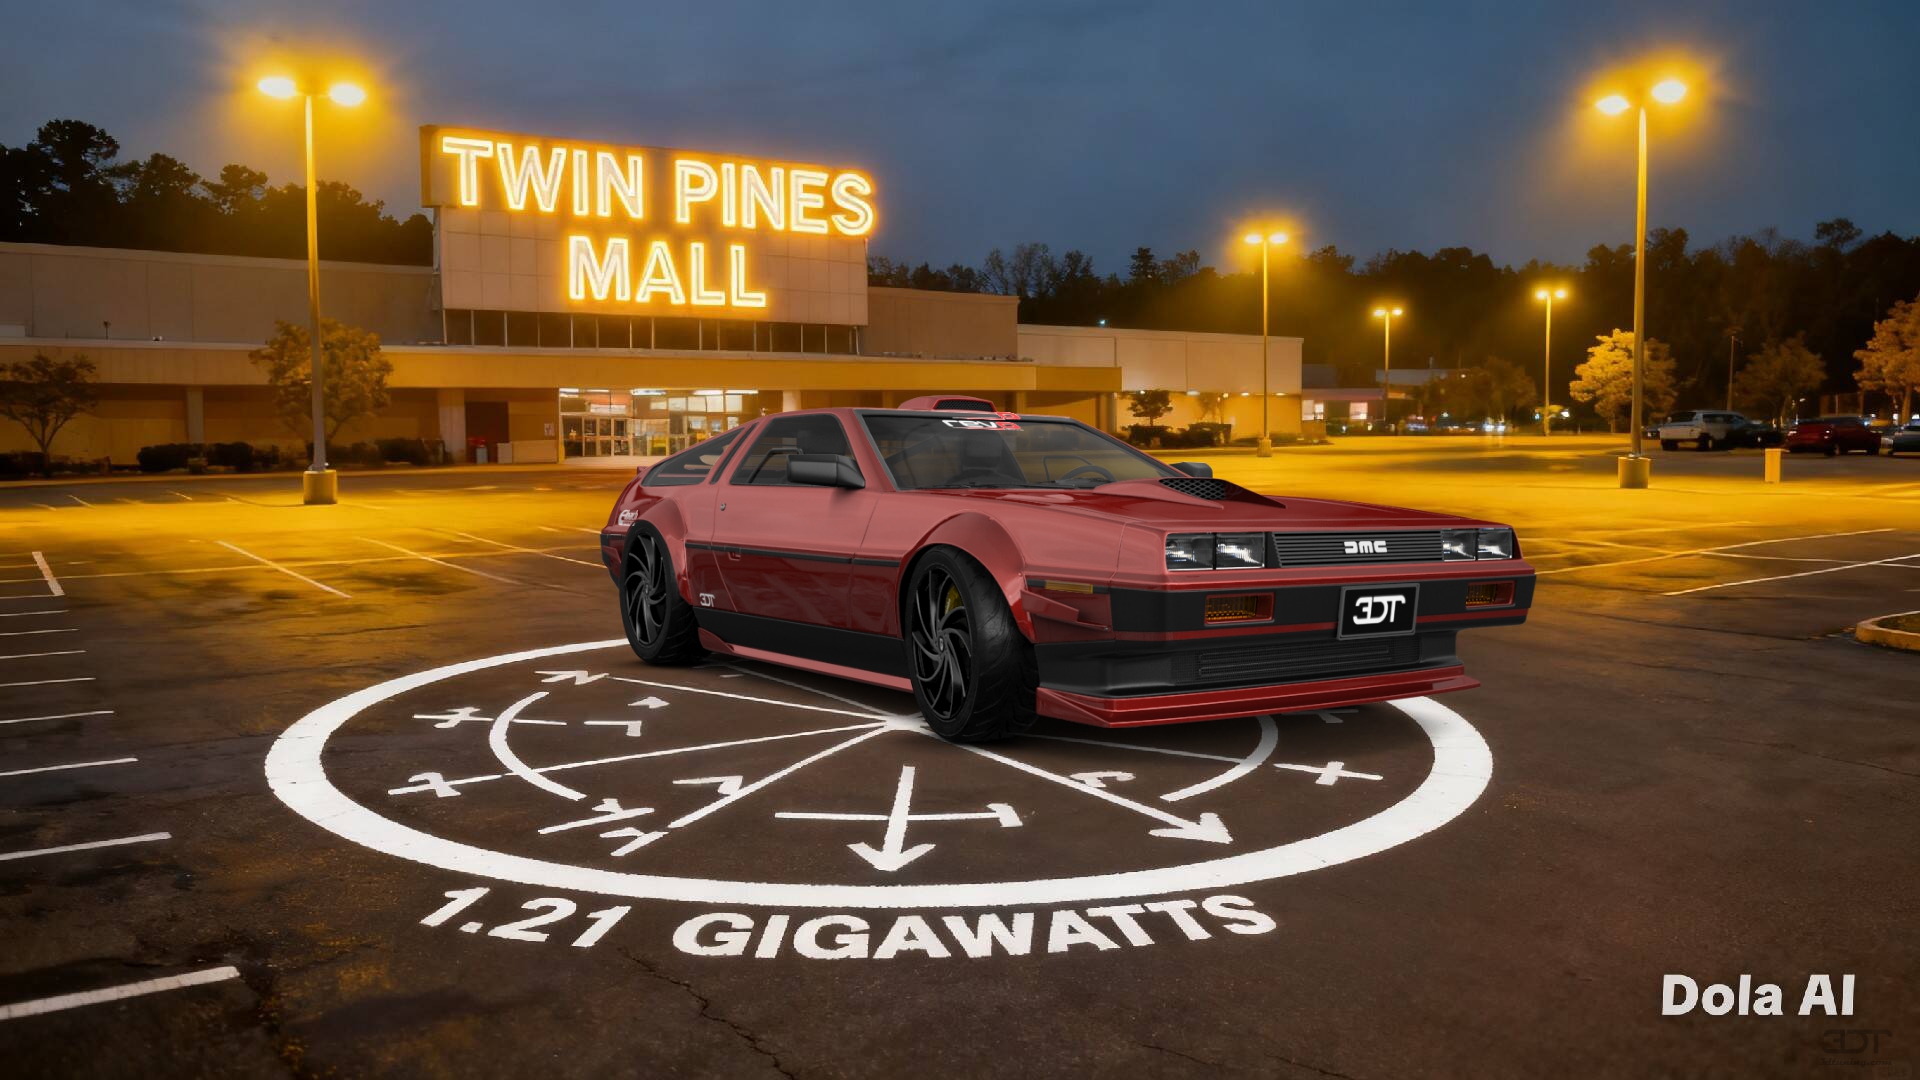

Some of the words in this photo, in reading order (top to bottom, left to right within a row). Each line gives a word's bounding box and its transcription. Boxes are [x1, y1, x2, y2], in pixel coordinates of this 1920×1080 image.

[442, 136, 645, 220] TWIN
[675, 159, 874, 236] PINES
[568, 234, 767, 308] MALL
[1353, 594, 1406, 625] 3DT
[419, 886, 632, 948] 1.21
[673, 894, 1277, 961] GIGAWATTS
